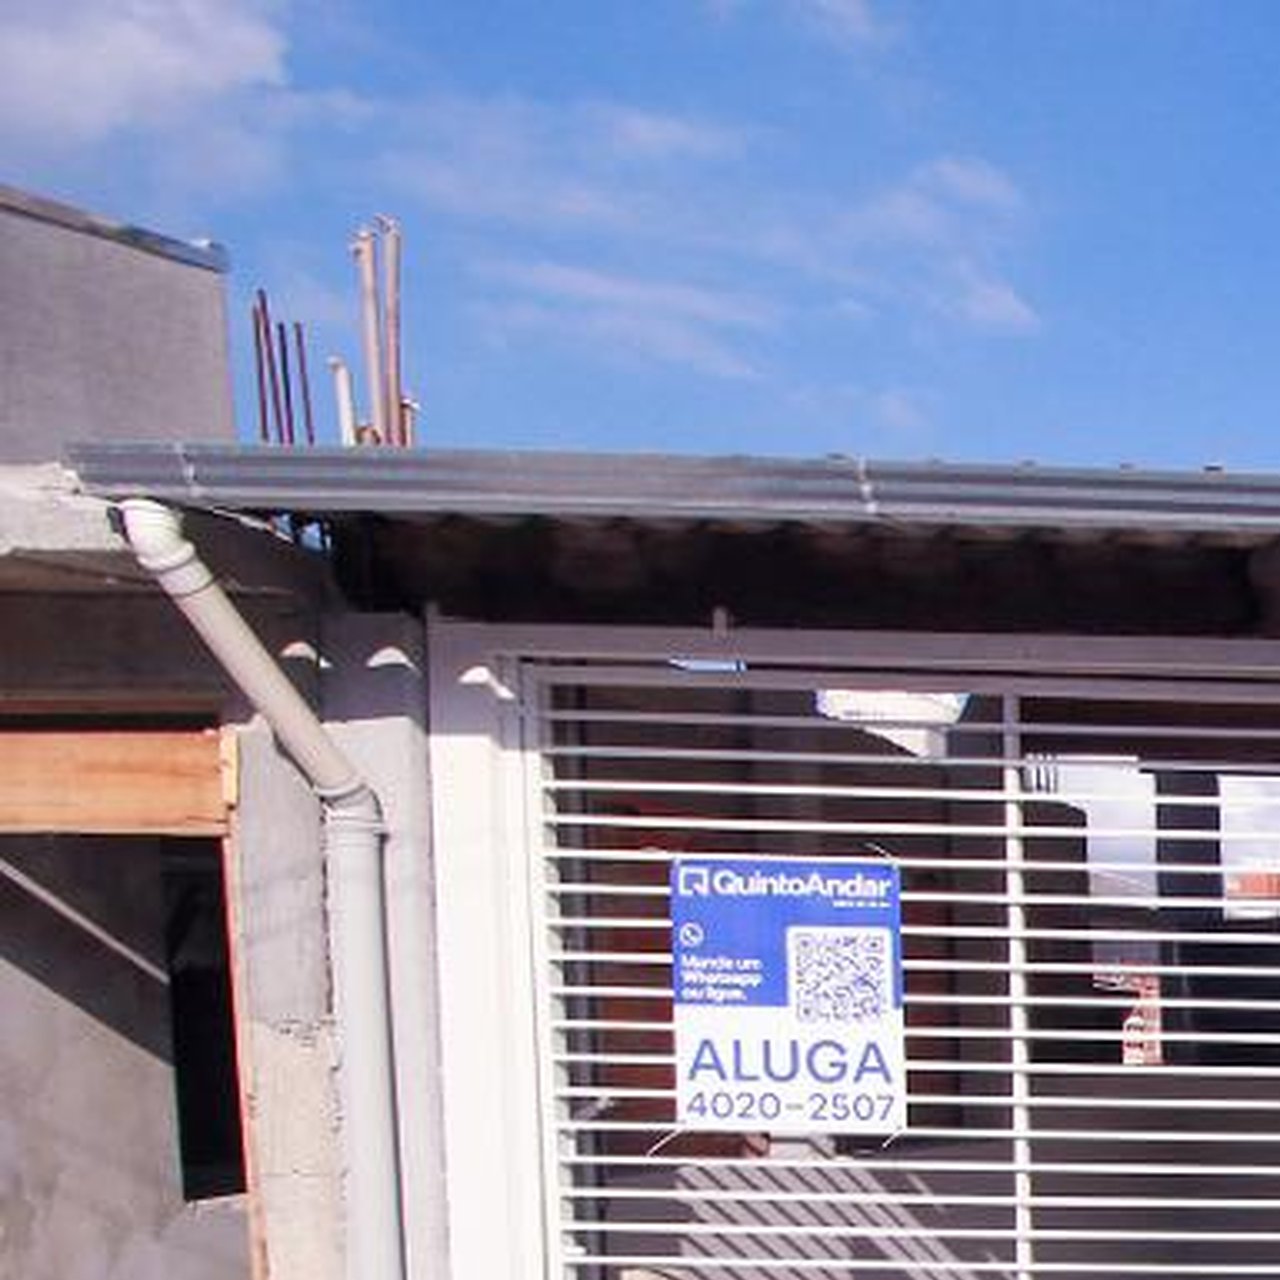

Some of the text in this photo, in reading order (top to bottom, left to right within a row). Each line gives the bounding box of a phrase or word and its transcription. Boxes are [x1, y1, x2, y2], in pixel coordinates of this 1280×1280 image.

[712, 869, 892, 898] QuintoAndar
[687, 1038, 893, 1085] ALUGA
[685, 1091, 895, 1122] 4020-2507
